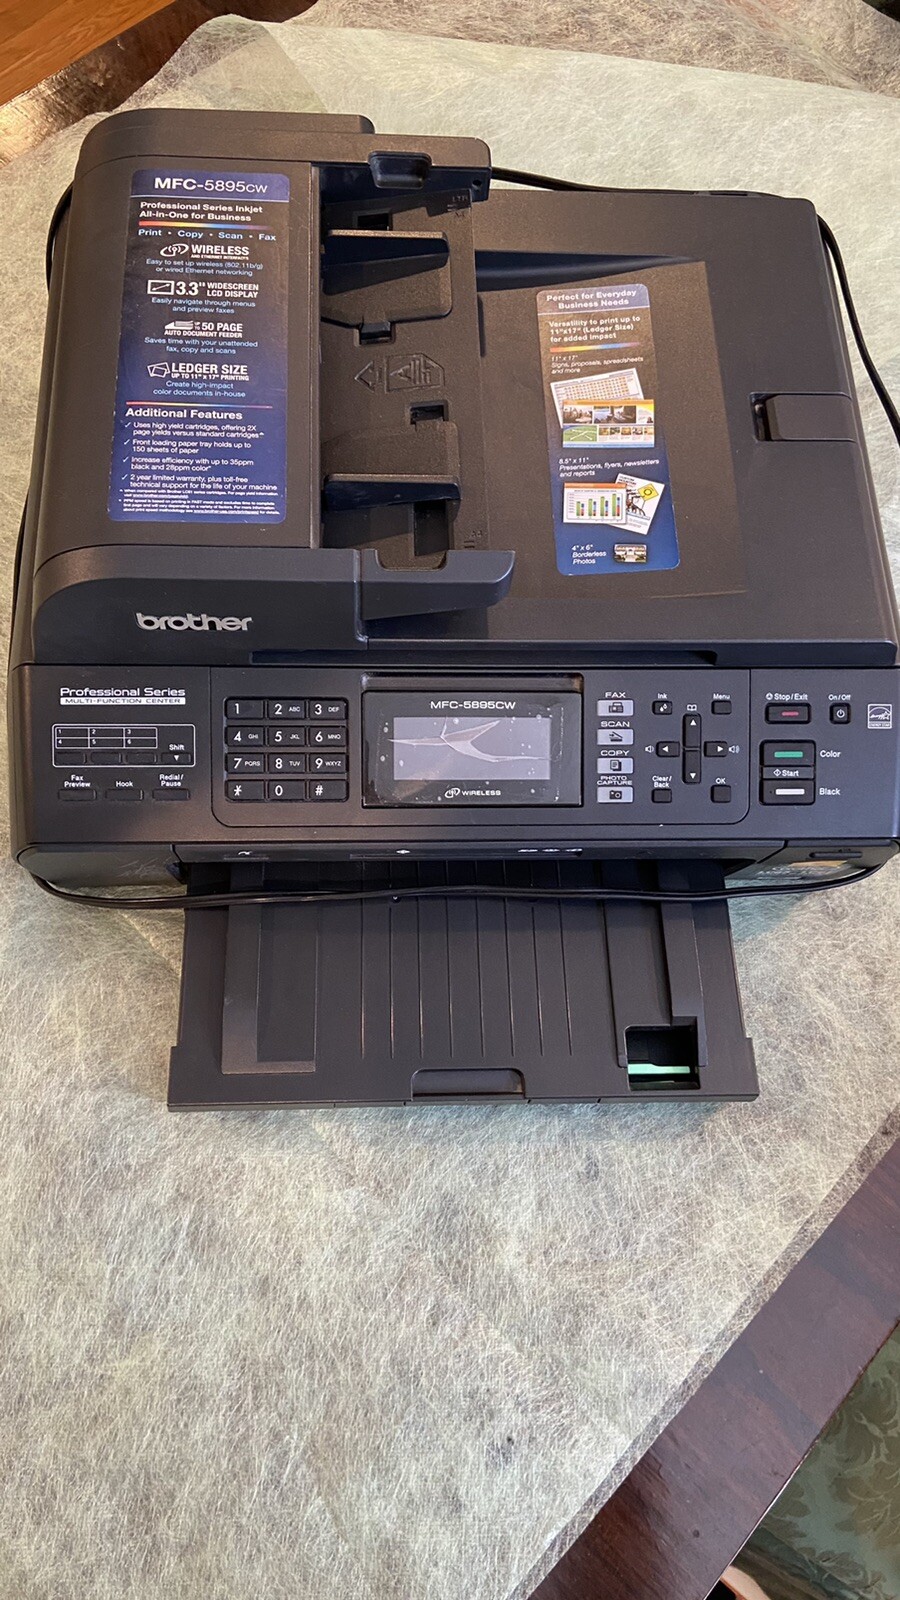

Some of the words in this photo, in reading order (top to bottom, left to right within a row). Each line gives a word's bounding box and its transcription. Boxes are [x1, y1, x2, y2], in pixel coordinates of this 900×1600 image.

[191, 244, 249, 255] WIRELESS
[207, 282, 258, 290] WIDESCREEN
[597, 290, 636, 298] Everyday
[217, 323, 243, 331] PAGE
[600, 318, 618, 326] print
[172, 363, 218, 374] LEDGER
[222, 364, 247, 374] SIZE
[126, 408, 186, 418] Additional
[191, 410, 242, 419] Features
[136, 613, 252, 630] brother
[60, 688, 140, 696] Professional
[144, 688, 185, 696] Series
[235, 703, 239, 714] 1
[275, 704, 282, 715] 2
[315, 704, 322, 715] 3
[430, 701, 516, 709] MFC-5895CW
[234, 731, 241, 741] 4
[275, 731, 282, 742] 5
[315, 732, 322, 742] 6
[234, 758, 242, 768] 7
[275, 758, 282, 769] 8
[315, 758, 323, 768] 9
[275, 785, 283, 796] 0
[315, 785, 323, 795] #
